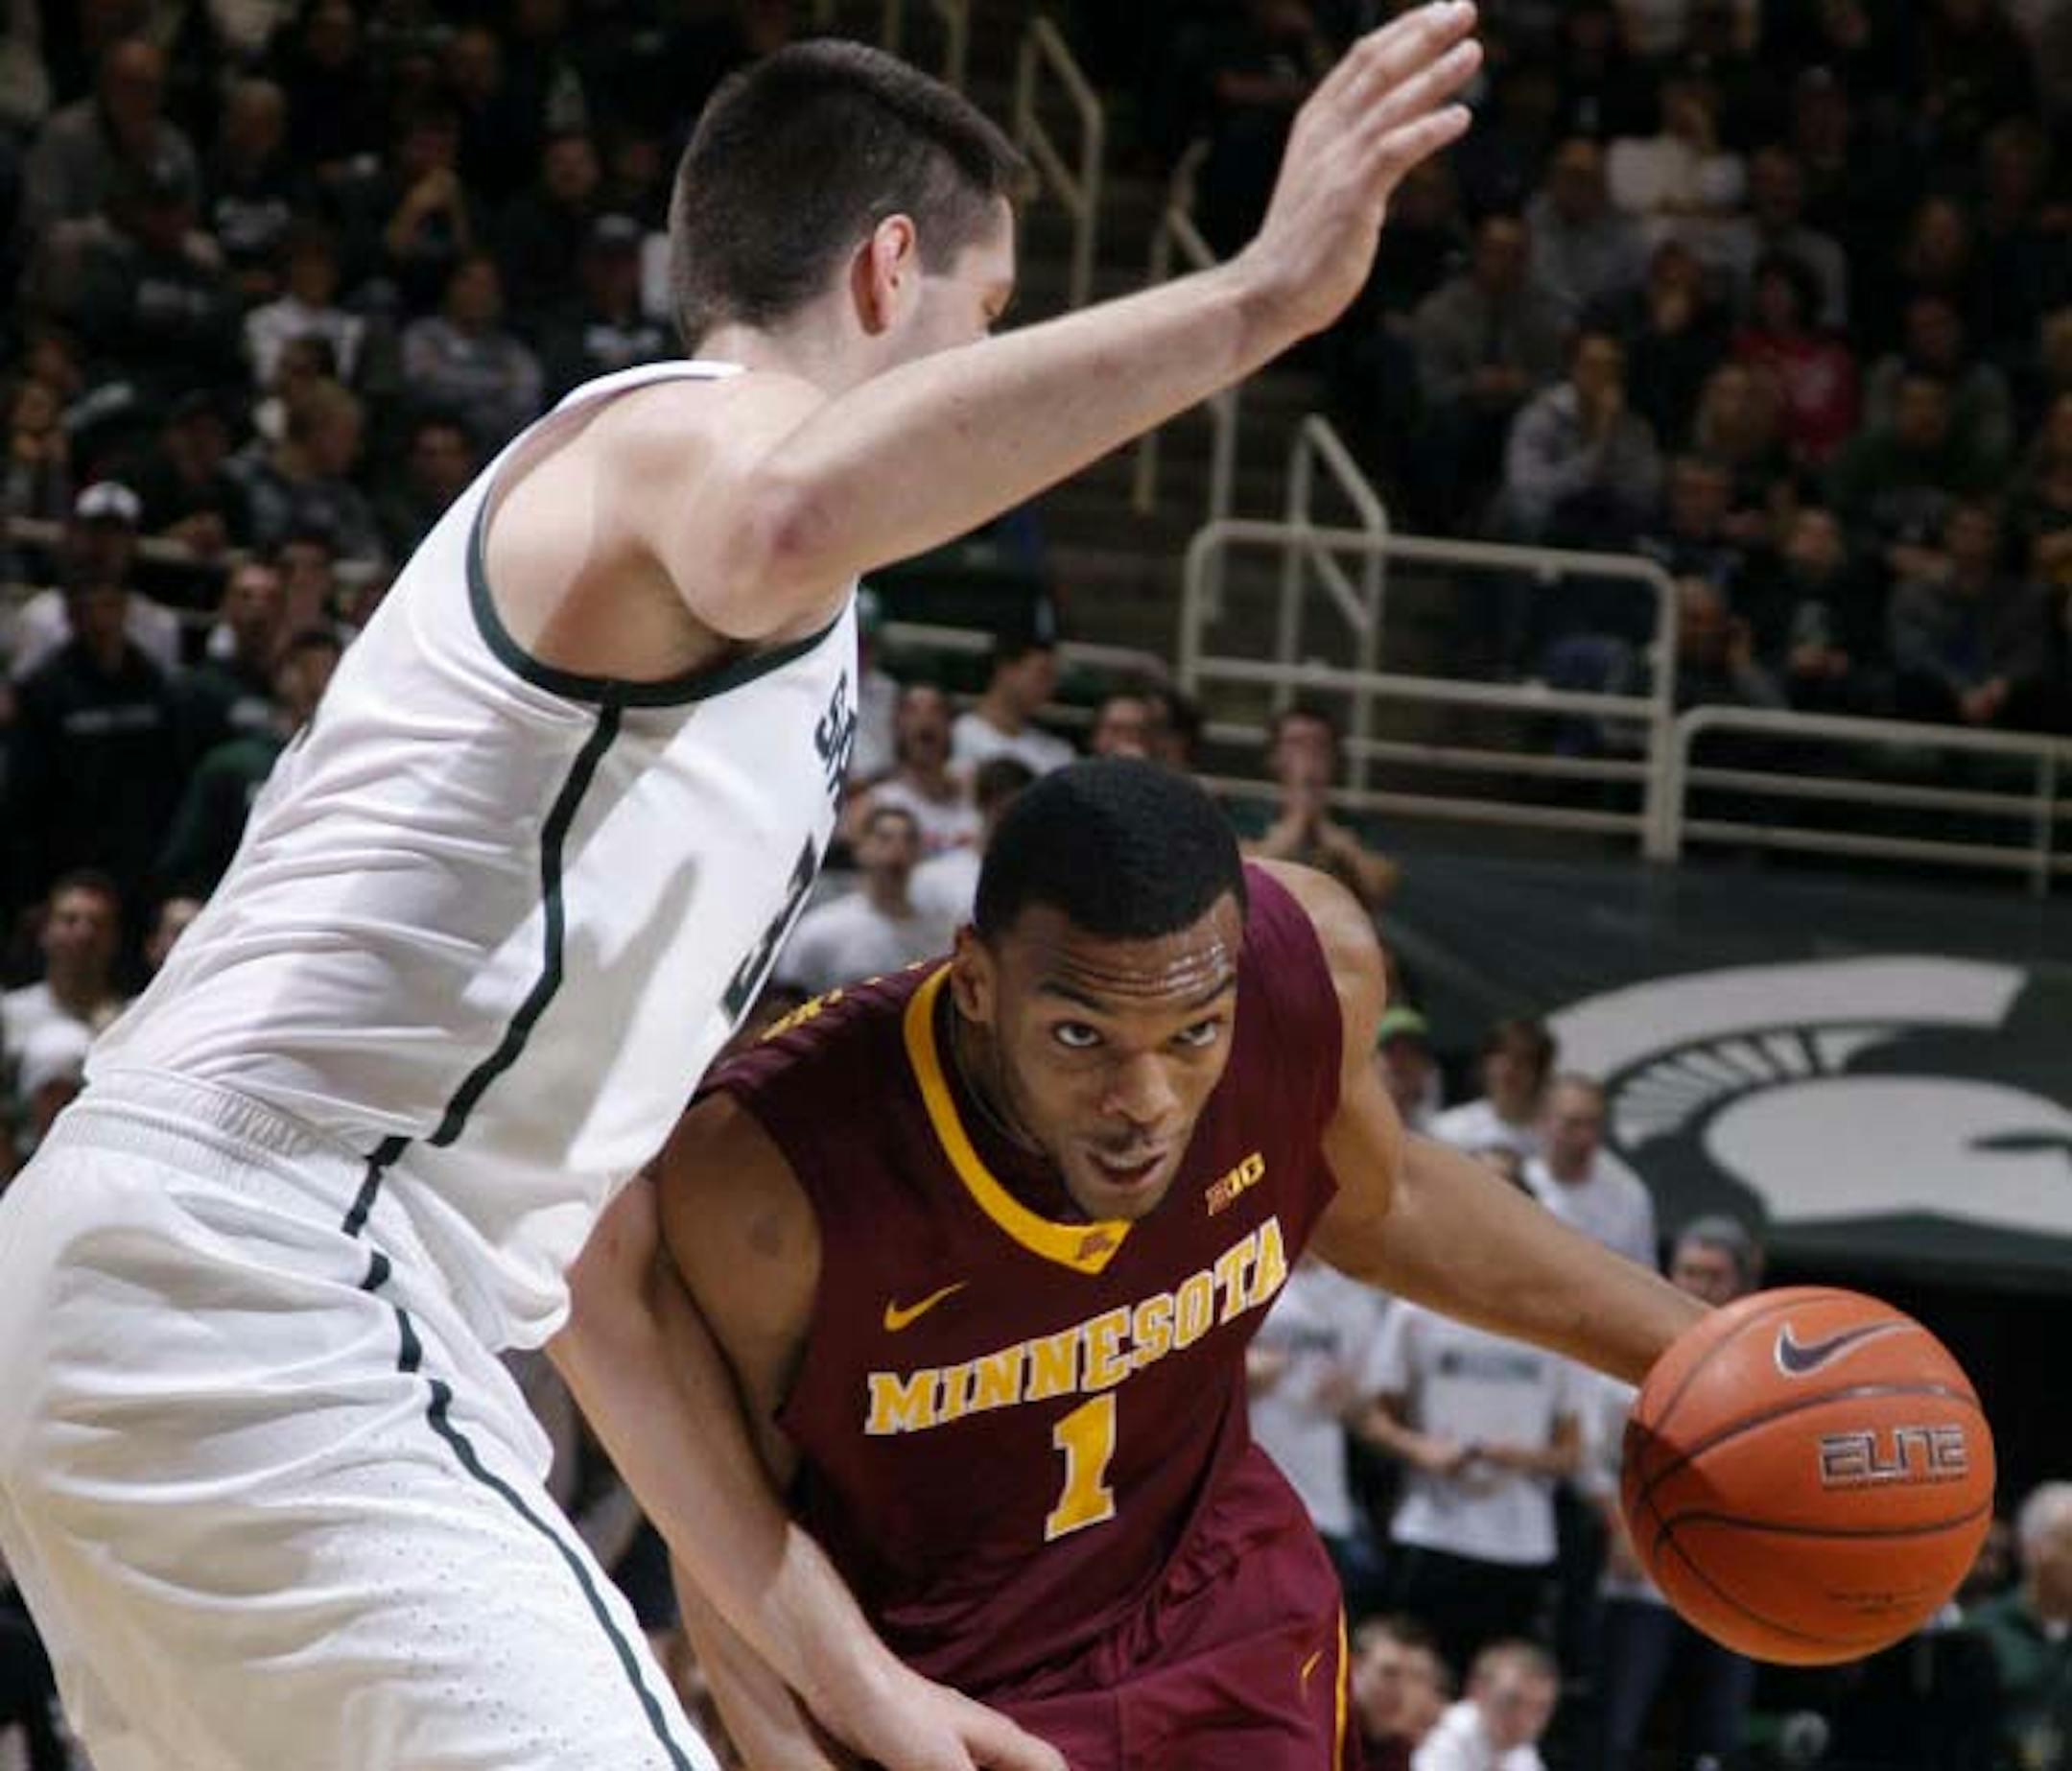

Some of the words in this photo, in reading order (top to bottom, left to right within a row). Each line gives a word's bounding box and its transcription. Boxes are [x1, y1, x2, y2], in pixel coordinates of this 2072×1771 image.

[865, 1215, 1287, 1435] MINNESOTA
[1045, 1392, 1117, 1542] 1
[1820, 1424, 1968, 1485] ELITE
